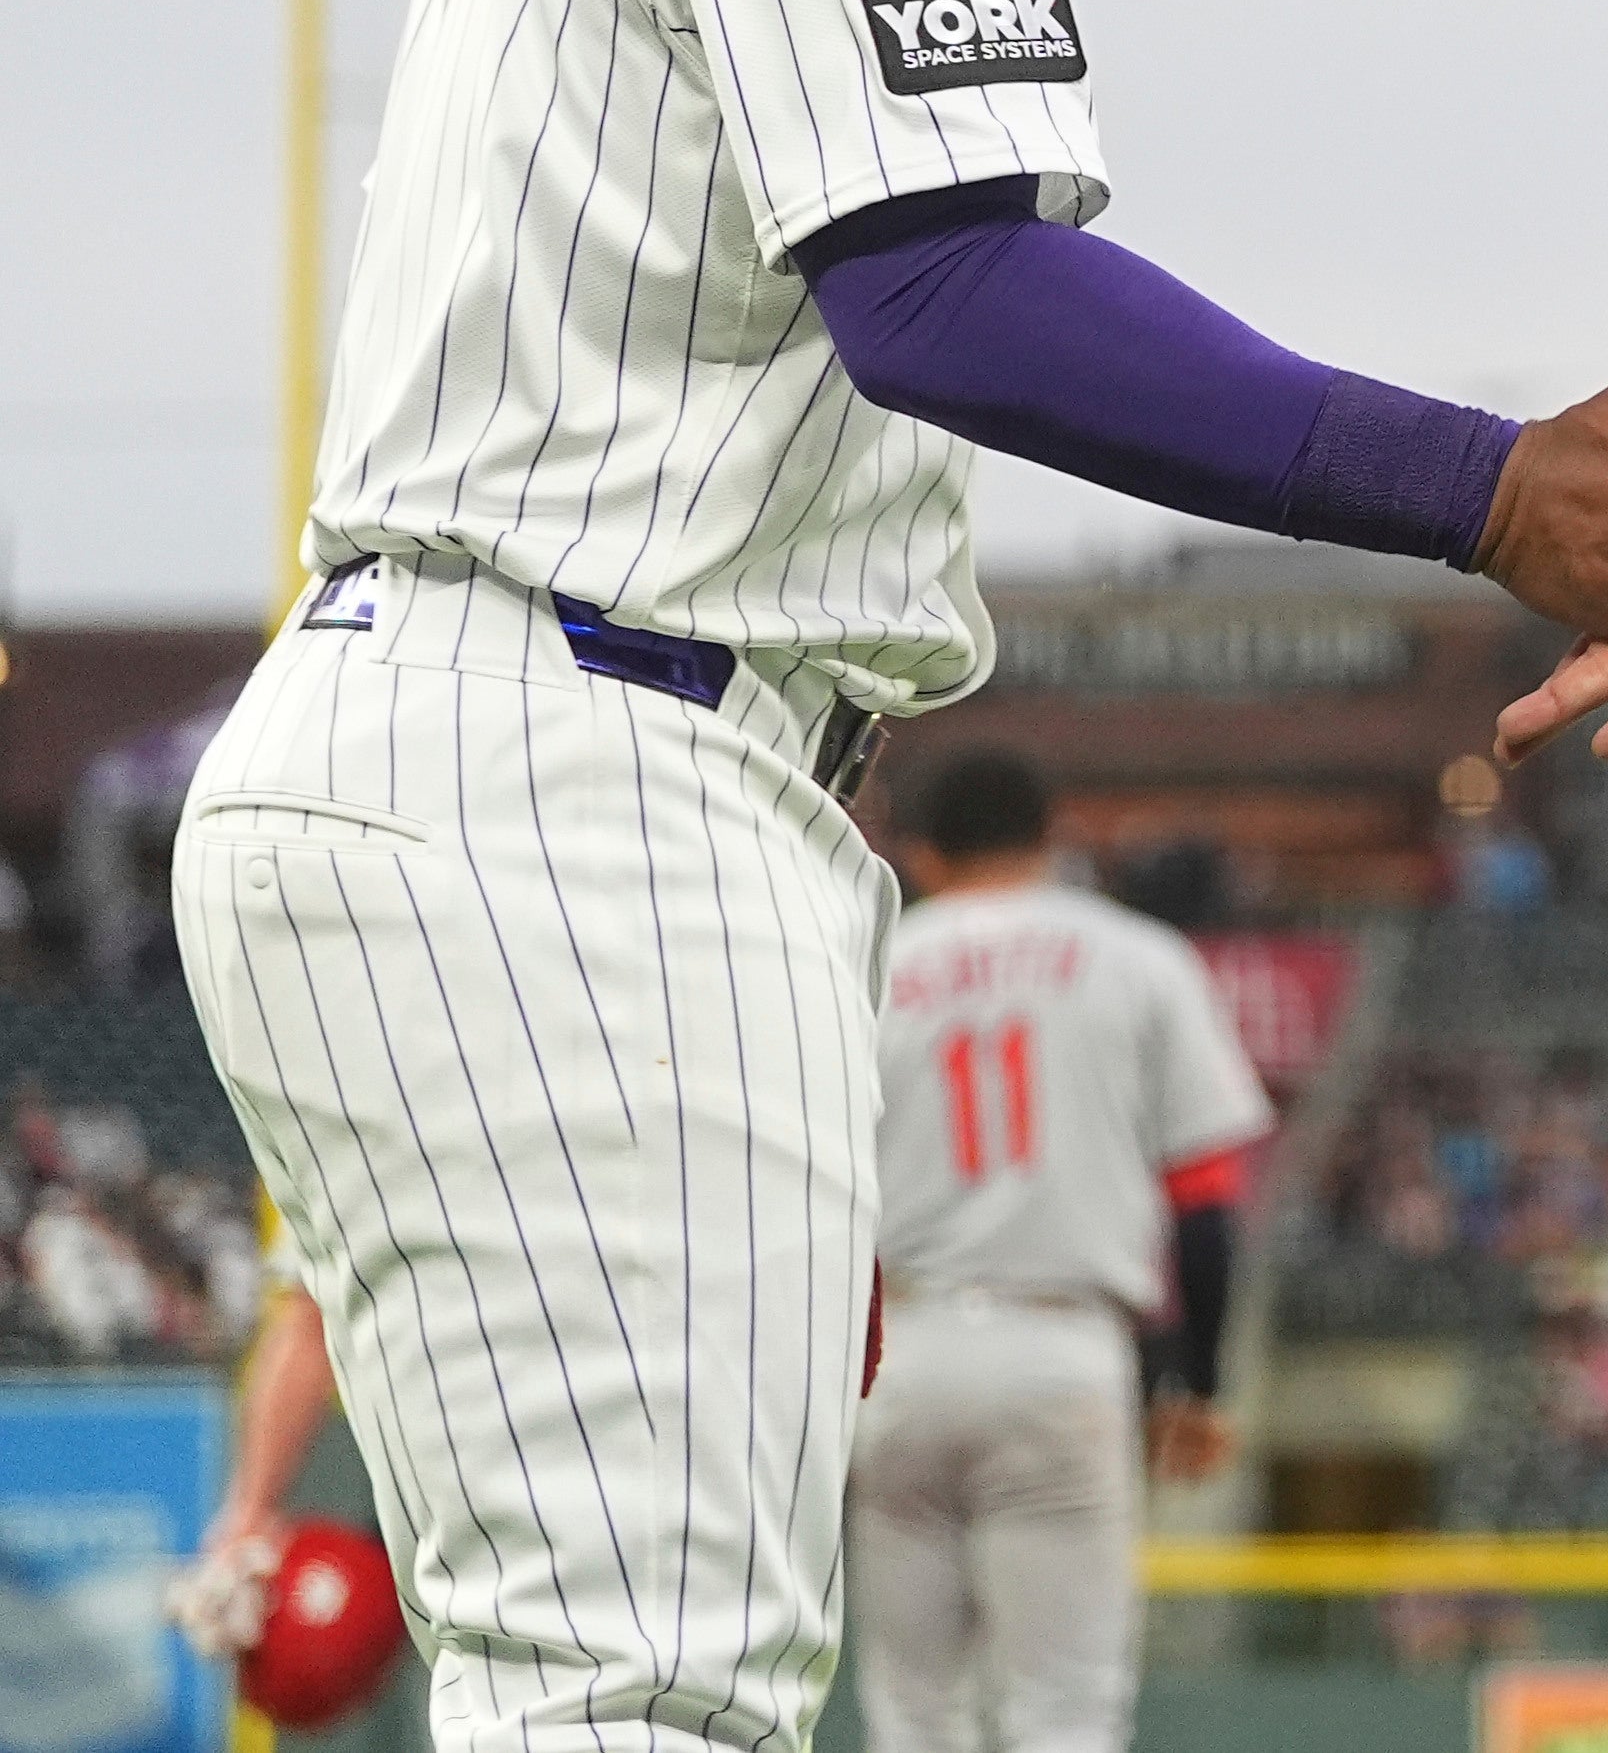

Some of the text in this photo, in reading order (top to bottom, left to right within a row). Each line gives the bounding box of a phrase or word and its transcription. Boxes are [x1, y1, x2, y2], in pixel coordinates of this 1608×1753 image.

[902, 39, 1078, 70] SPACE SYSTEMS
[938, 1016, 1038, 1186] 11
